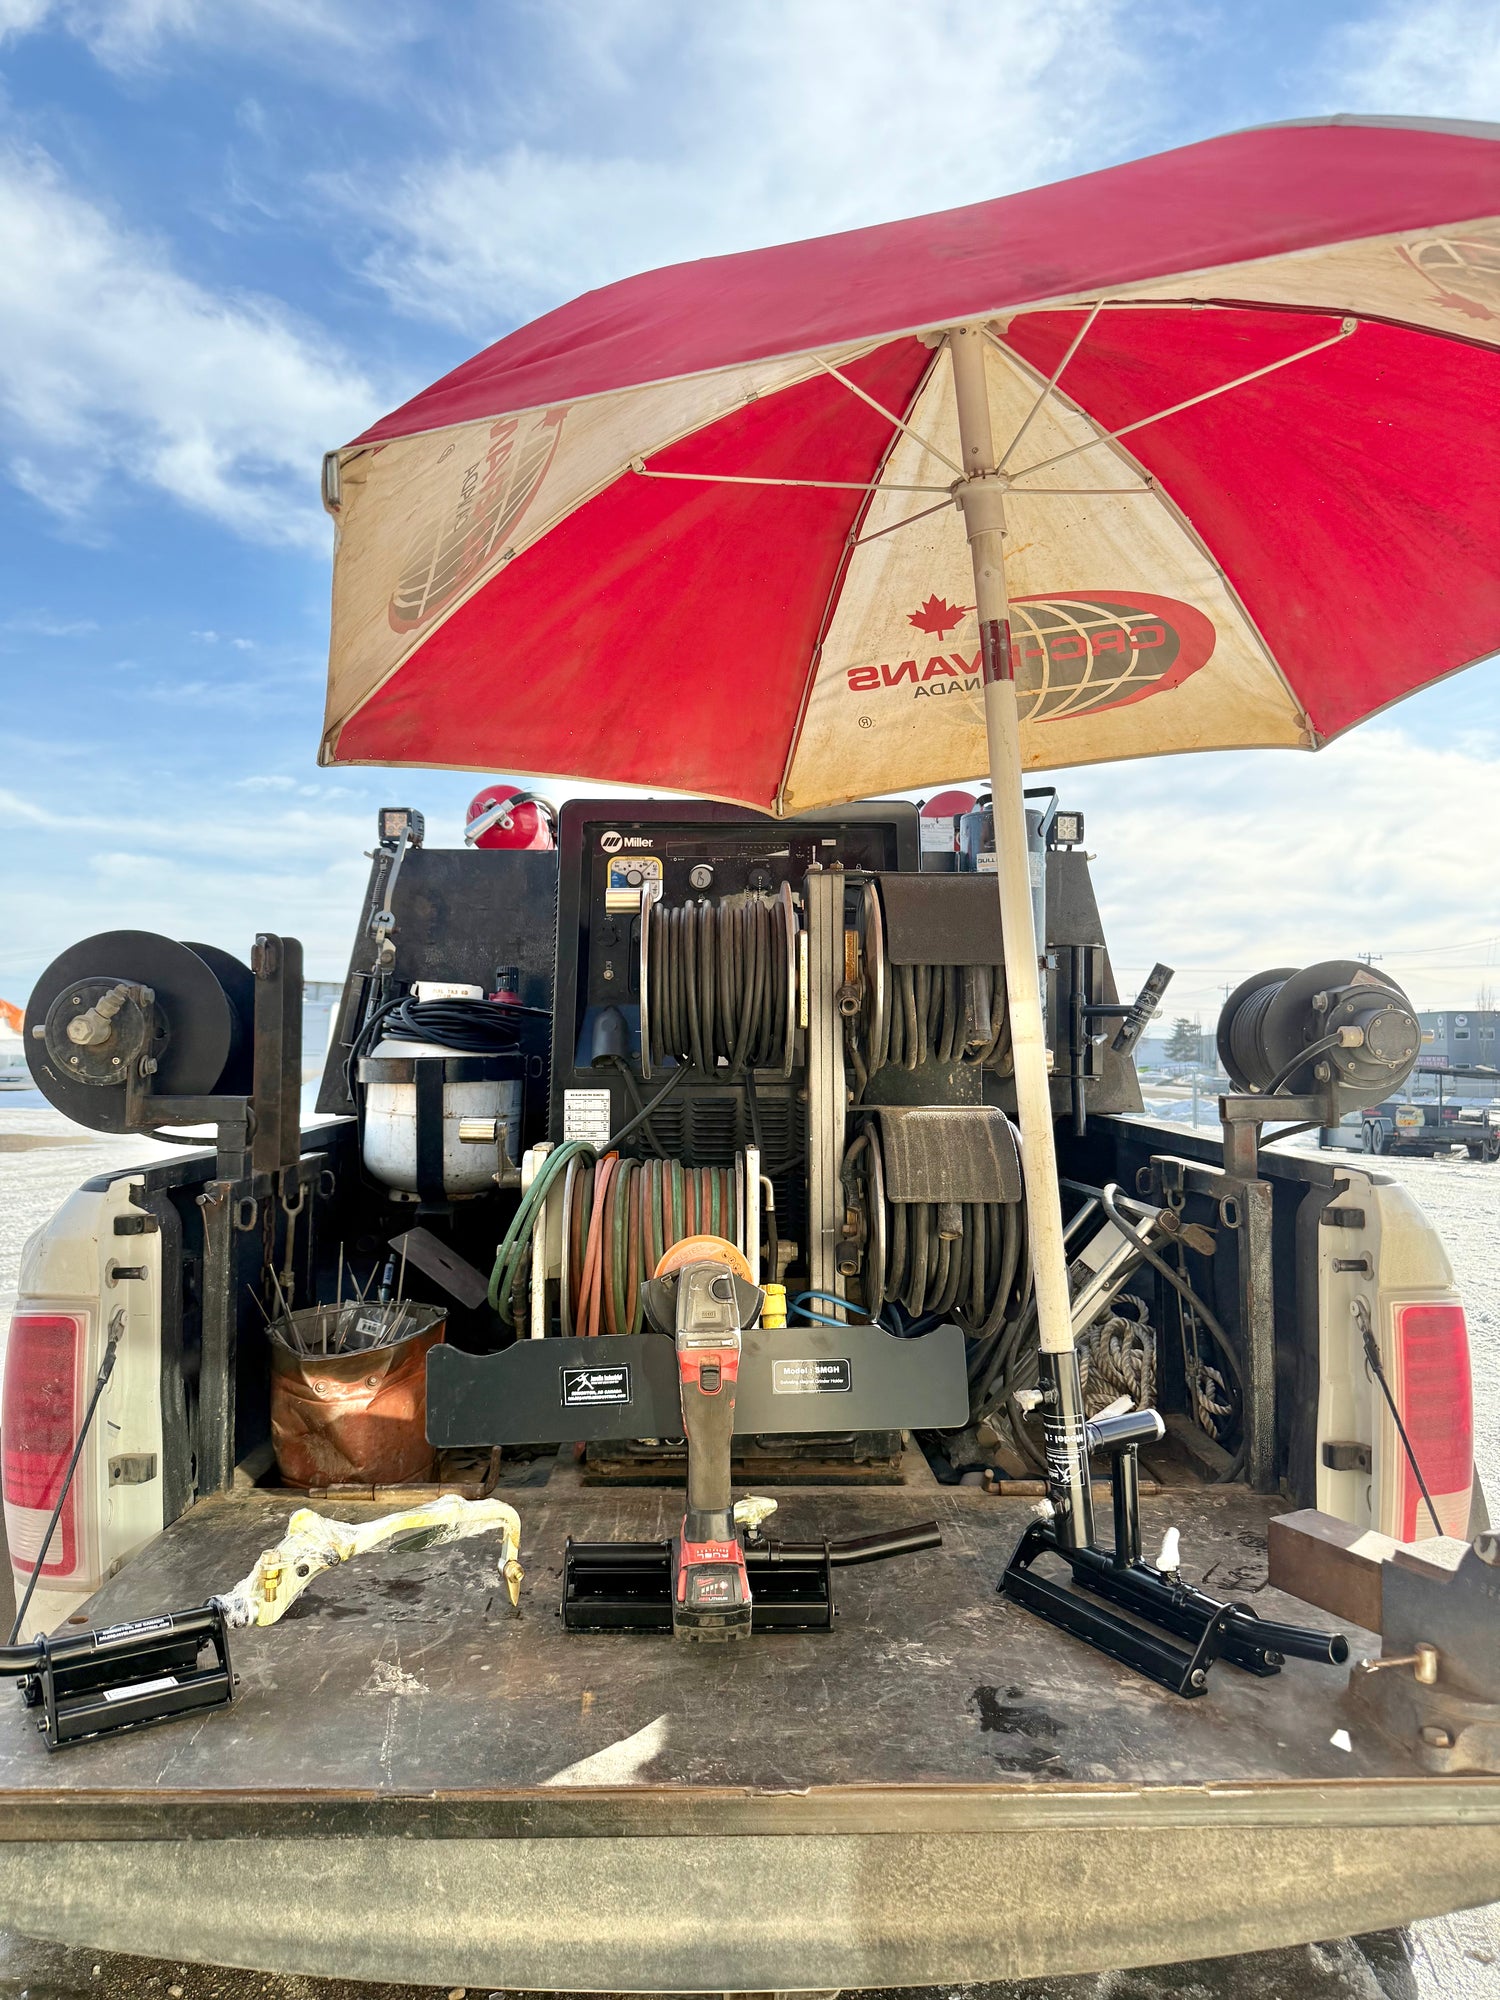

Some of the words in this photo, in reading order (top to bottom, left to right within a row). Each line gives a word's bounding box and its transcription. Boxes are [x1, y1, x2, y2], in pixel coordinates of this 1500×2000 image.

[623, 837, 654, 848] Miller
[783, 1366, 808, 1375] Model
[815, 1366, 840, 1374] SMGH
